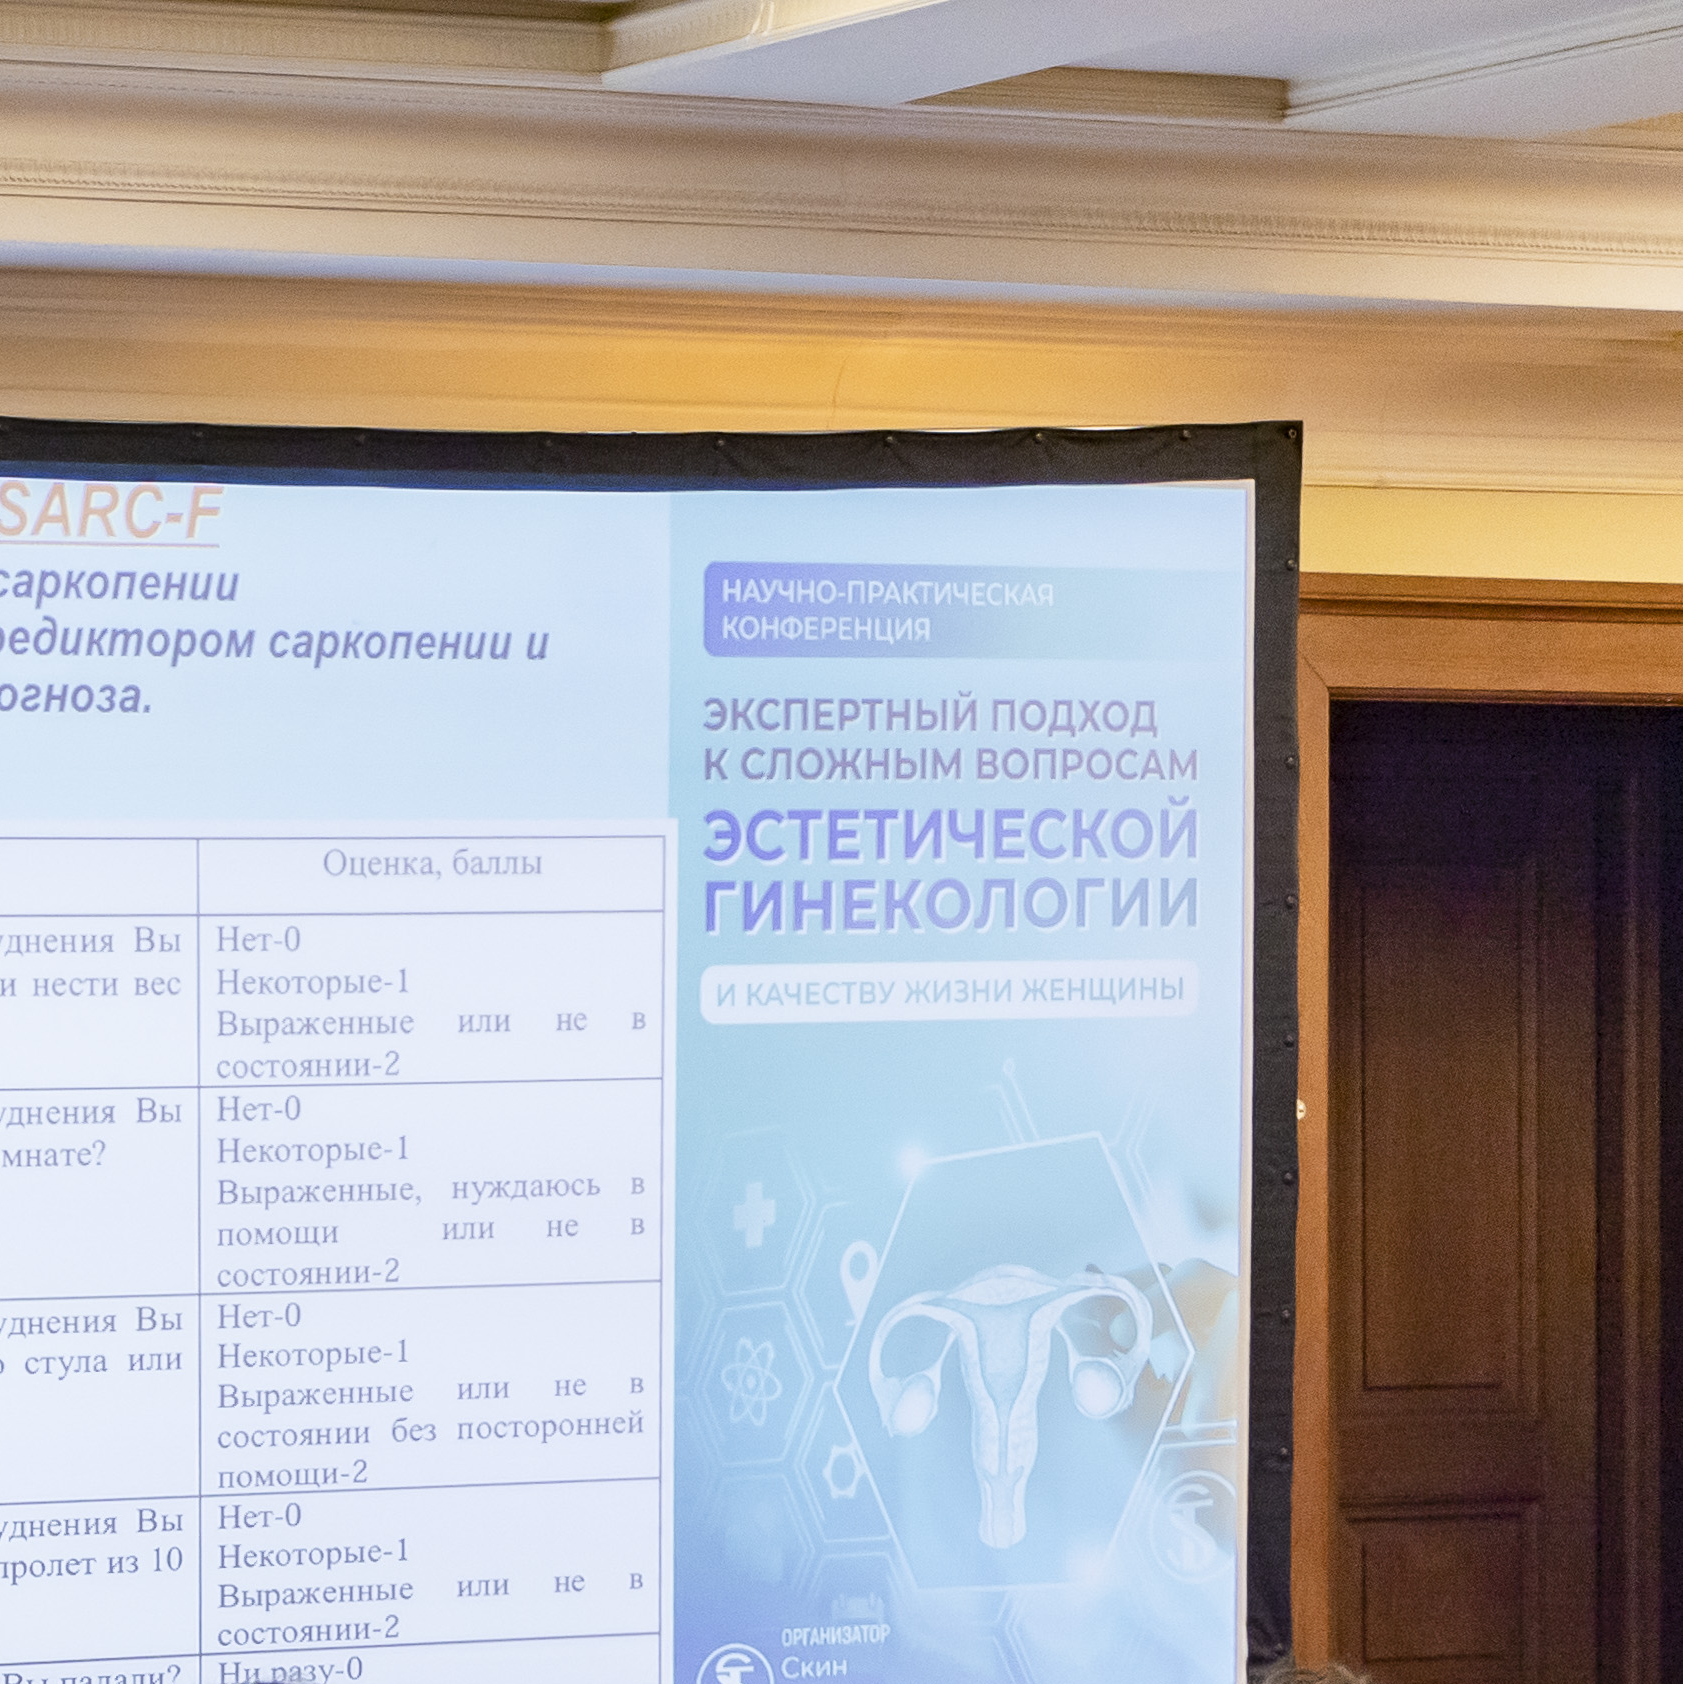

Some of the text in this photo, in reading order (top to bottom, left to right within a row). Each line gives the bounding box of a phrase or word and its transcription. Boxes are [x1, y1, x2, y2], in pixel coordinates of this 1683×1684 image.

[722, 579, 1054, 606] НАУЧНО-ПРАКТИЧЕСКАЯ
[722, 616, 931, 643] КОНФЕРЕНЦИЯ
[268, 629, 513, 670] саркопении
[526, 632, 550, 661] и
[703, 690, 1158, 737] ЭКСПЕРТНЫЙ ПОДХОД
[704, 748, 1198, 781] К СЛОЖНЫМ ВОПРОСАМ
[703, 796, 1198, 863] ЭСТЕТИЧЕСКОЙ
[322, 847, 543, 880] Оценка, баллы
[705, 878, 1198, 933] ГИНЕКОЛОГИИ
[134, 925, 181, 953] Вы
[216, 925, 301, 953] Нет-0
[0, 977, 17, 997] и
[32, 977, 119, 998] нести
[134, 976, 181, 997] вес
[216, 967, 409, 1001] Некоторые-1
[717, 977, 1185, 1008] И КАЧЕСТВУ ЖИЗНИ ЖЕНЩИНЫ
[217, 1009, 511, 1045] Выраженные или
[216, 1049, 400, 1080] состоянии-2
[136, 1096, 182, 1124] Вы
[216, 1094, 302, 1123] Нет-0
[217, 1134, 408, 1170] Некоторые-1
[217, 1177, 601, 1211] Выраженные, нуждаюсь
[217, 1221, 495, 1247] помощи или
[216, 1257, 400, 1288] состоянии-2
[136, 1305, 183, 1332] Вы
[217, 1301, 302, 1330] Нет-0
[24, 1354, 109, 1382] стула
[128, 1352, 182, 1372] или
[217, 1338, 408, 1373] Некоторые-1
[218, 1381, 510, 1416] Выраженные или
[217, 1409, 644, 1450] состоянии без посторонней
[218, 1458, 368, 1489] помощи-2
[137, 1508, 183, 1533] Вы
[218, 1502, 302, 1530] Нет-0
[107, 1555, 140, 1575] из
[153, 1546, 184, 1573] 10
[218, 1537, 408, 1571] Некоторые-1
[218, 1578, 510, 1613] Выраженные или
[217, 1613, 400, 1647] состоянии-2
[782, 1624, 891, 1647] ОРГАНИЗАТОР
[782, 1656, 847, 1679] Скин
